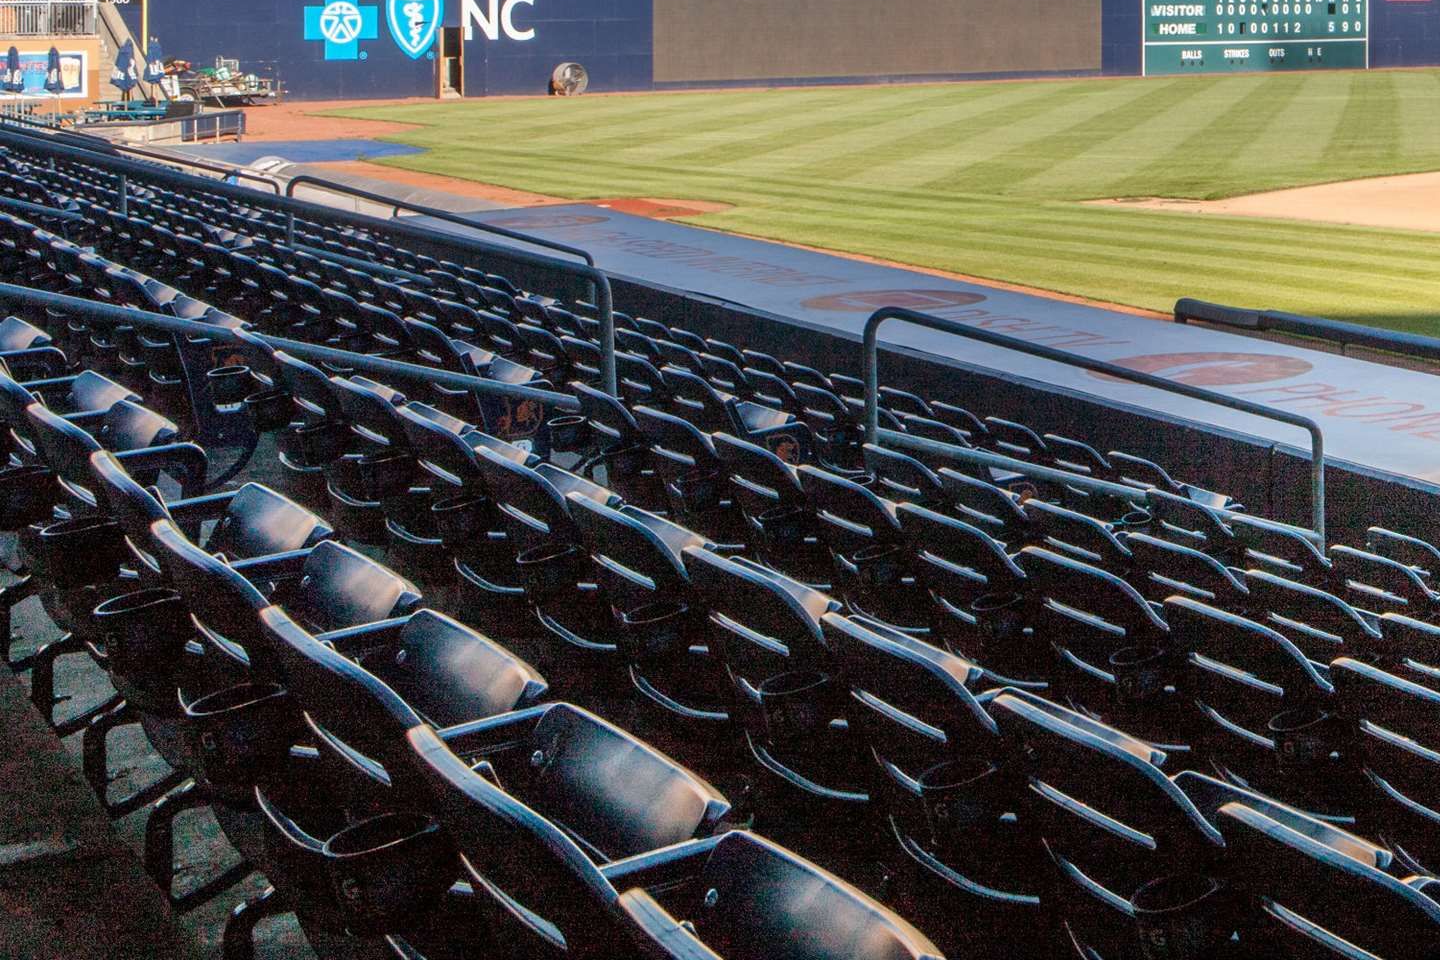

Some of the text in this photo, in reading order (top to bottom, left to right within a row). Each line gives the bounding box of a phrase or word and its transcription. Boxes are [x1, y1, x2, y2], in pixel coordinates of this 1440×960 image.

[1152, 4, 1361, 16] VISITOR 0 0 0 0 0 0 0 0 0 1
[1160, 21, 1361, 34] HOME 1 0 0 0 1 1 2 5 9 0
[1182, 50, 1202, 59] BALLS
[1223, 49, 1250, 58] STRIKES
[1269, 48, 1285, 57] OUTS
